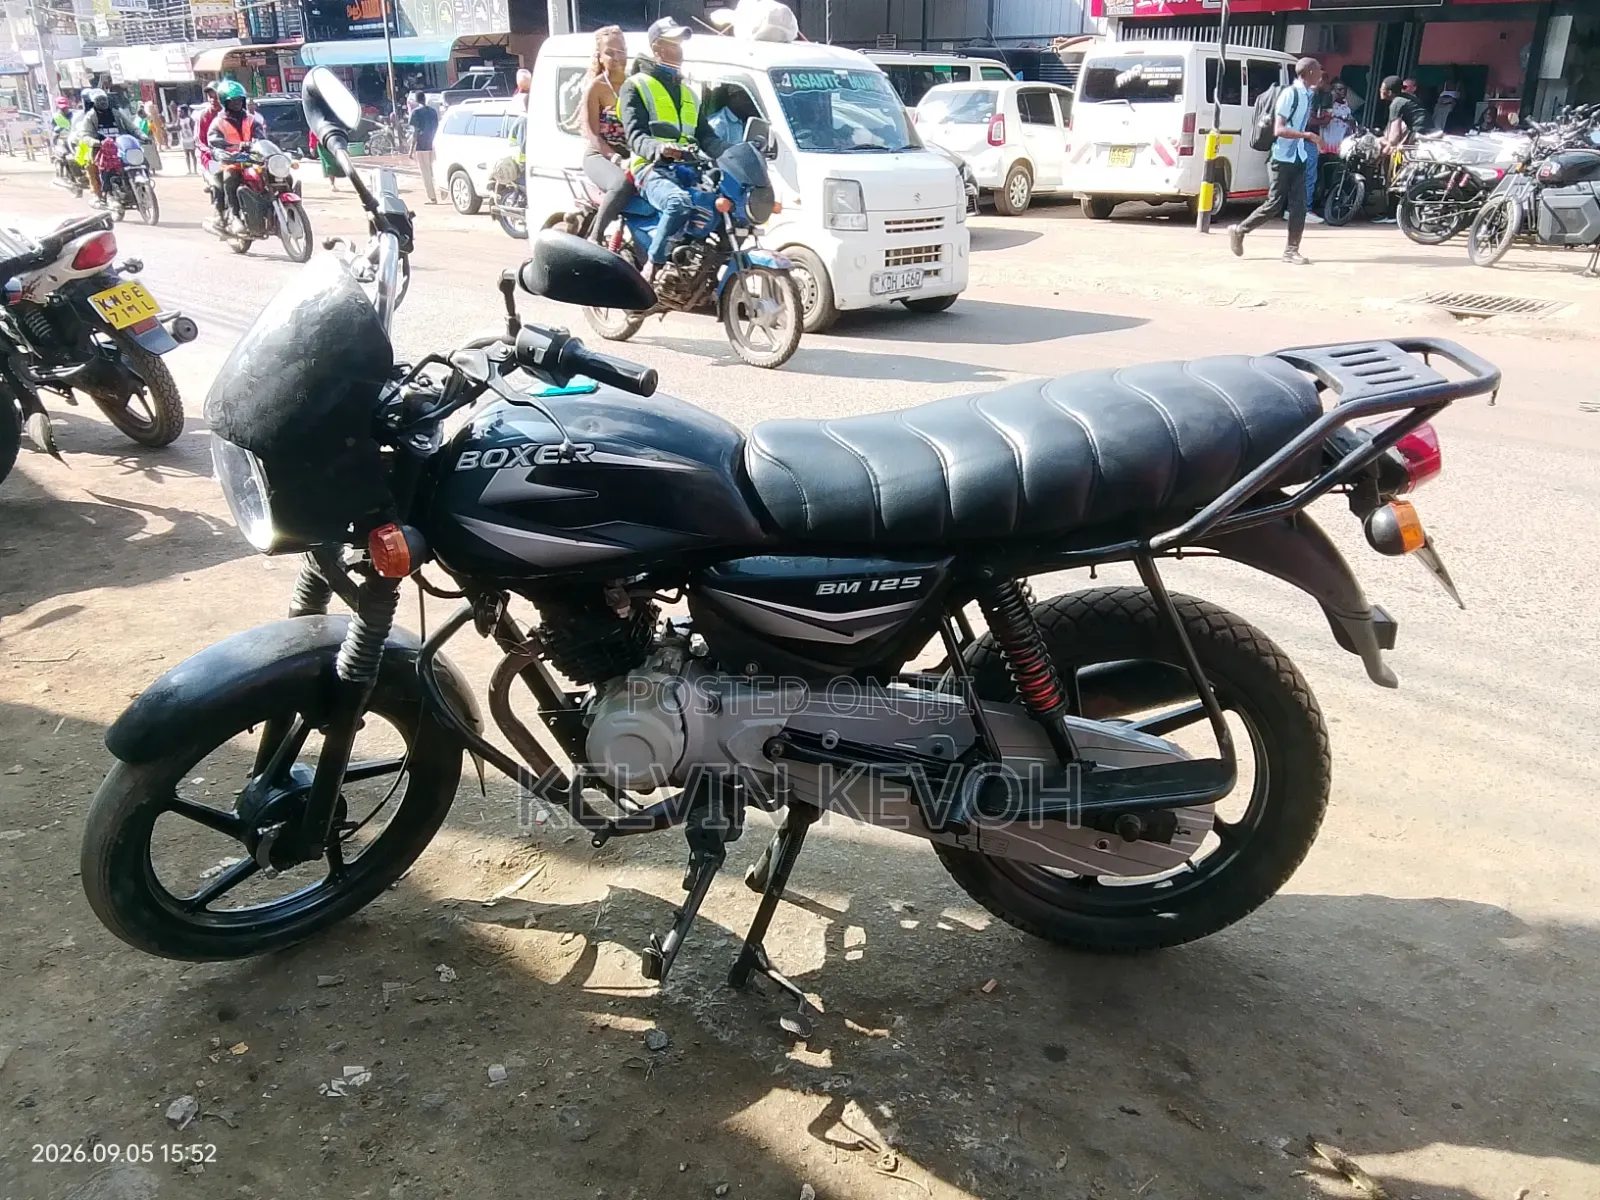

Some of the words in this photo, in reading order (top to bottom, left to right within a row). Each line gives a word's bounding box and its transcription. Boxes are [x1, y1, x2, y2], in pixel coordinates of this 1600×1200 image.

[790, 73, 841, 88] ASANTE
[880, 275, 898, 290] KDH
[109, 301, 155, 323] 719L
[454, 442, 596, 472] BOXER
[815, 581, 862, 596] BM
[869, 576, 922, 592] 125
